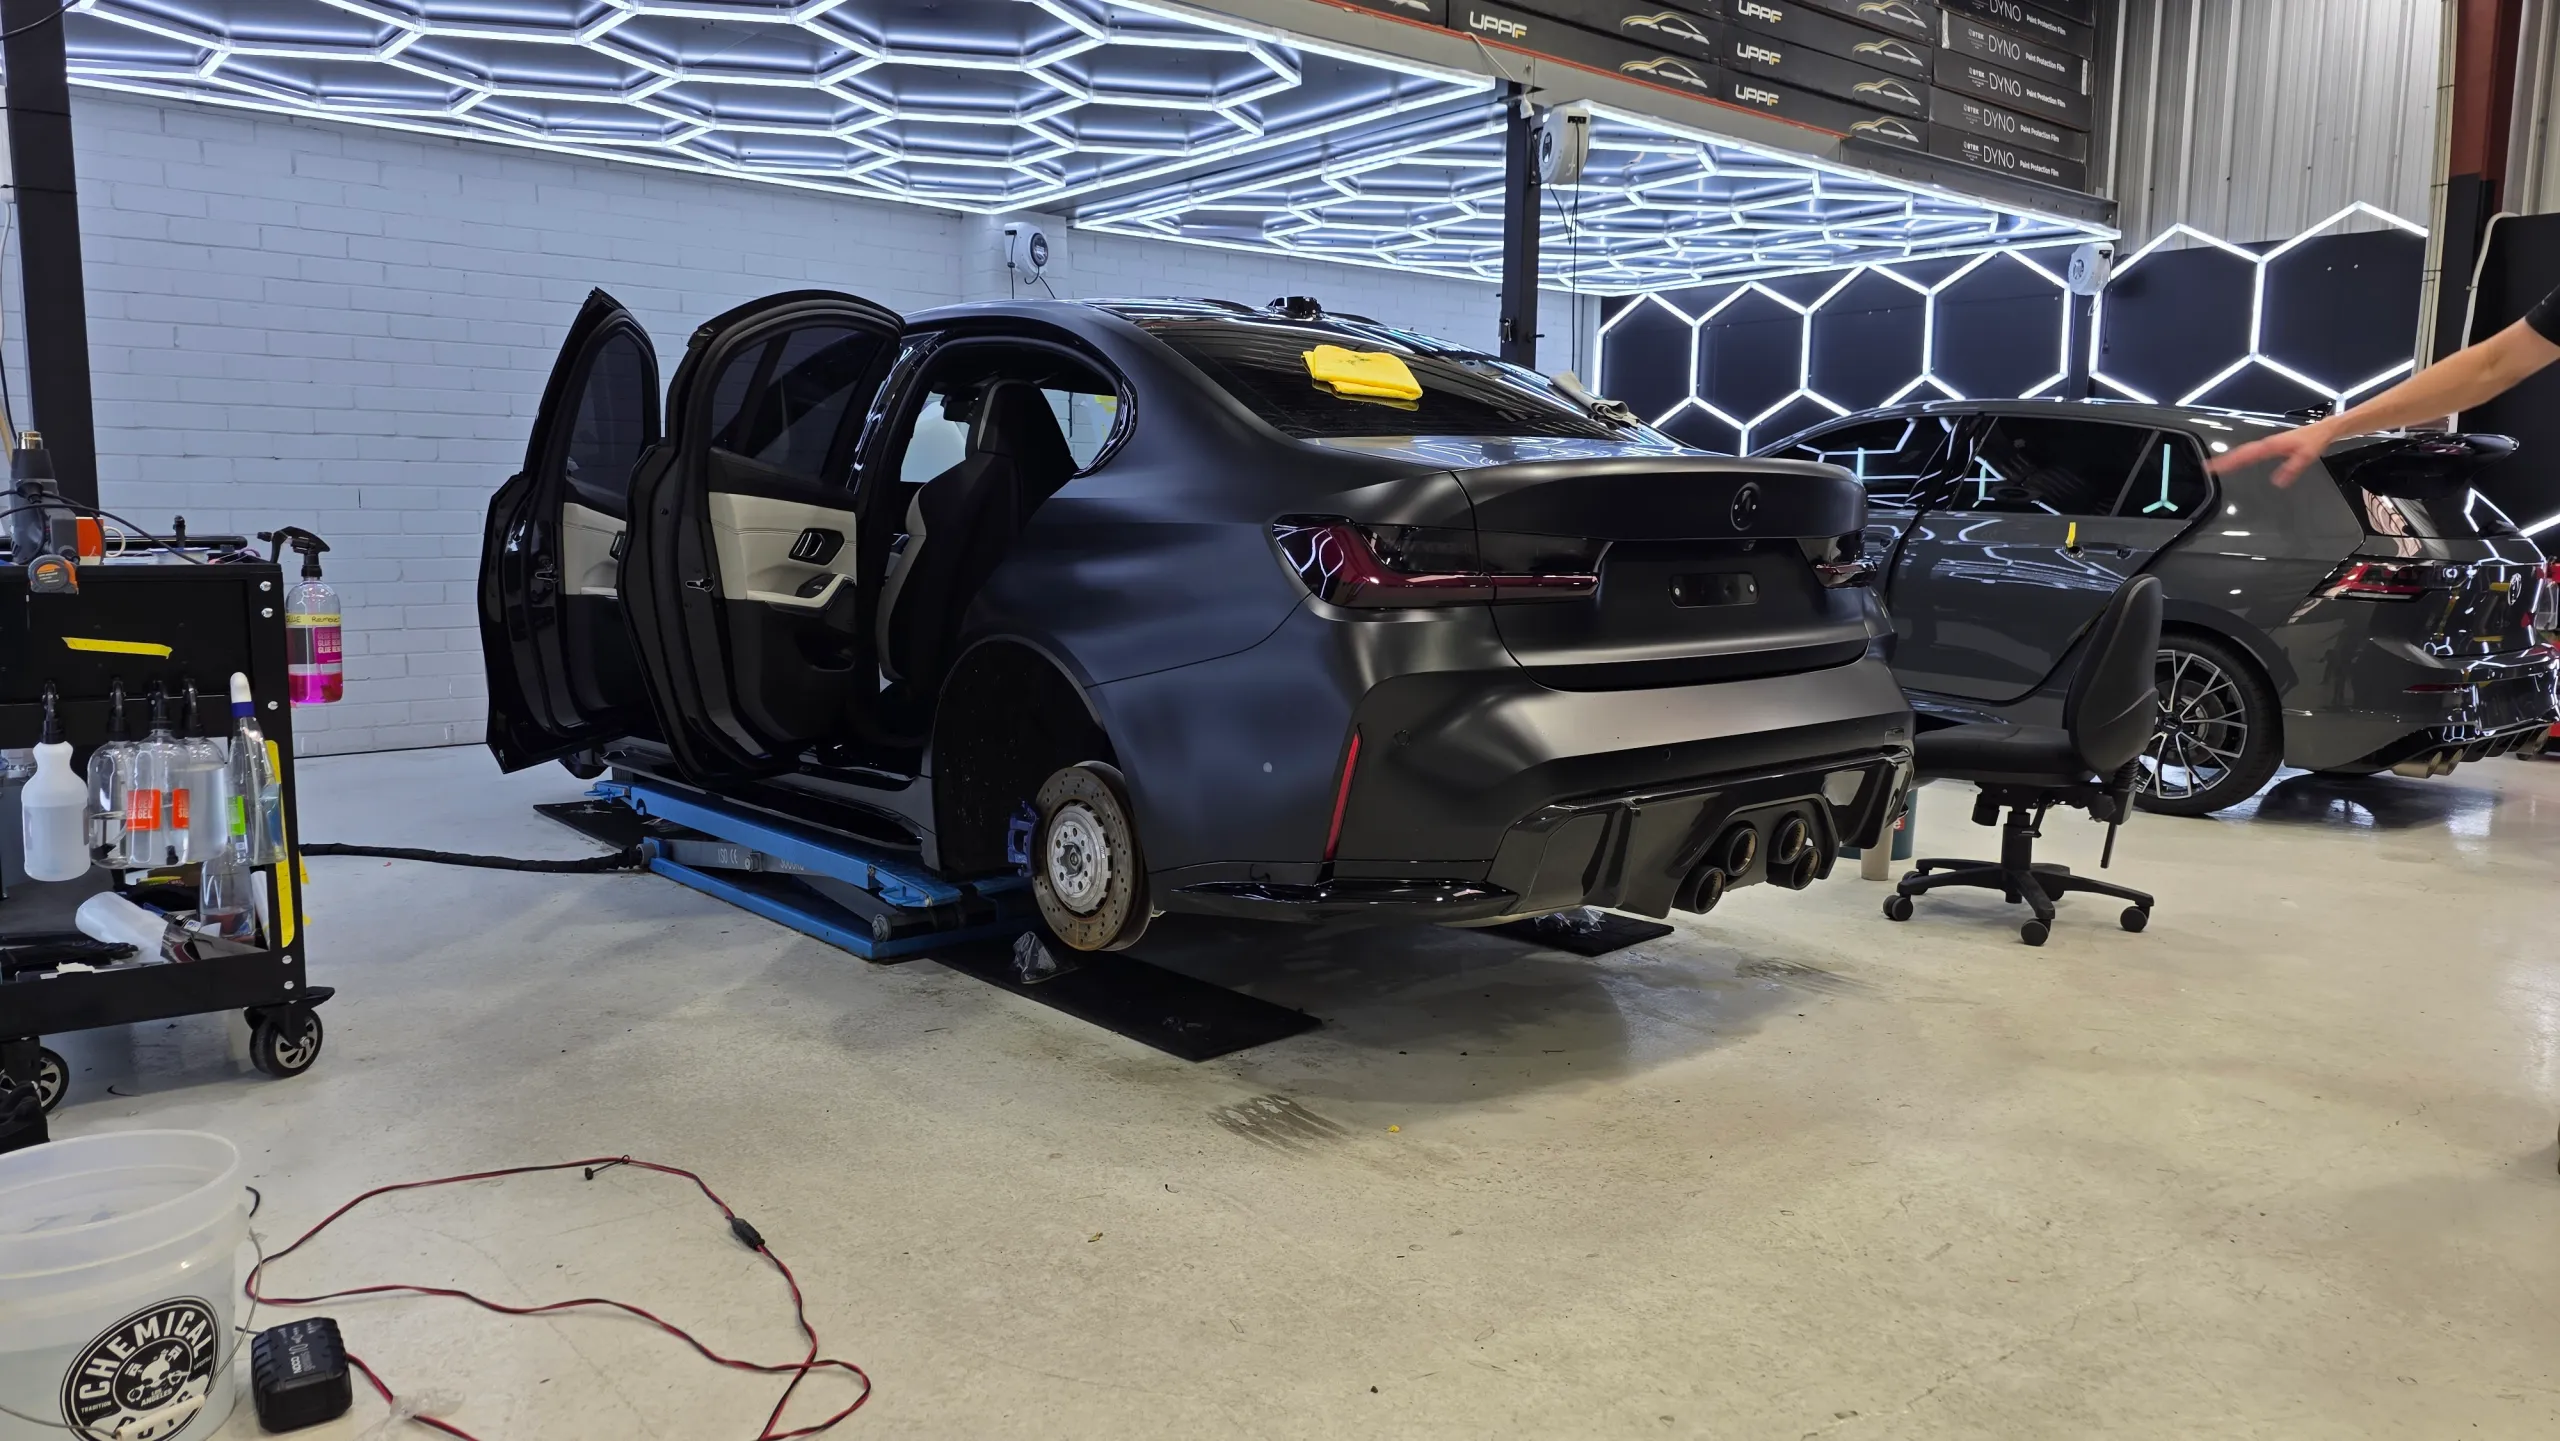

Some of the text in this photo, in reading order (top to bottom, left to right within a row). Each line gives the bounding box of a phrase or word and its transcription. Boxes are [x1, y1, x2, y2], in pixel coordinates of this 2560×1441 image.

[1738, 0, 1783, 24] UPPF
[1990, 0, 2022, 22] DYNO
[1469, 11, 1527, 39] UPPF
[2026, 14, 2067, 36] Paint Protection Film
[1737, 42, 1782, 66] UPPF
[1988, 34, 2021, 61] DYNO
[2025, 52, 2066, 73] Paint Protection Film
[1735, 83, 1779, 107] UPPF
[1989, 72, 2022, 98] DYNO
[2026, 88, 2066, 108] Paint Protection Film
[1983, 108, 2015, 133] DYNO
[2020, 124, 2060, 143] Paint Protection Film
[1983, 145, 2015, 169] DYNO
[2019, 159, 2060, 177] Paint Protection Film
[138, 809, 153, 819] GEL
[717, 847, 728, 864] ISO
[79, 1310, 212, 1400] CHEMICAL
[80, 1400, 112, 1414] TRADITION
[141, 1387, 173, 1408] ANGELES
